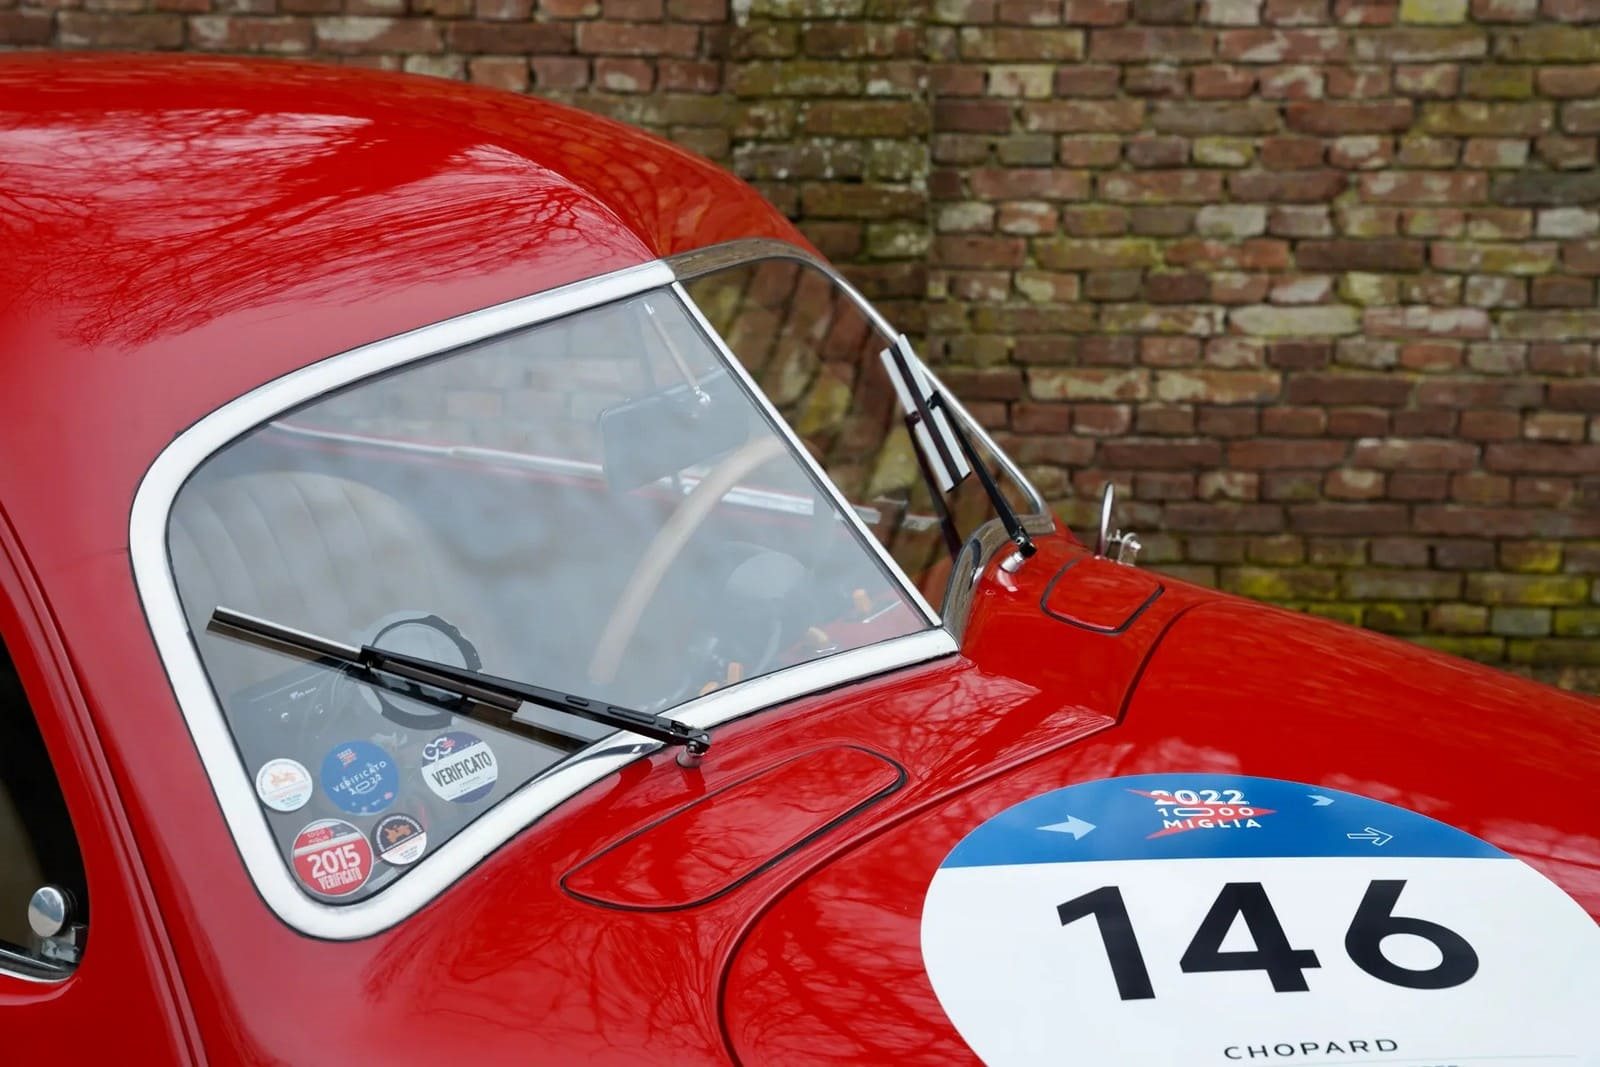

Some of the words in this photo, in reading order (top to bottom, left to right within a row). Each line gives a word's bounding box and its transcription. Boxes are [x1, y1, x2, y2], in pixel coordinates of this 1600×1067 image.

[332, 760, 387, 792] VERIFICATO
[432, 751, 492, 788] VERIFICATO
[1150, 789, 1250, 805] 2022
[1157, 807, 1254, 817] 1000
[1163, 818, 1262, 829] MIGLIA
[306, 843, 361, 879] 2015
[317, 866, 363, 890] VERIFICATO
[1056, 879, 1479, 1001] 146
[1223, 1039, 1398, 1060] CHOPARD
